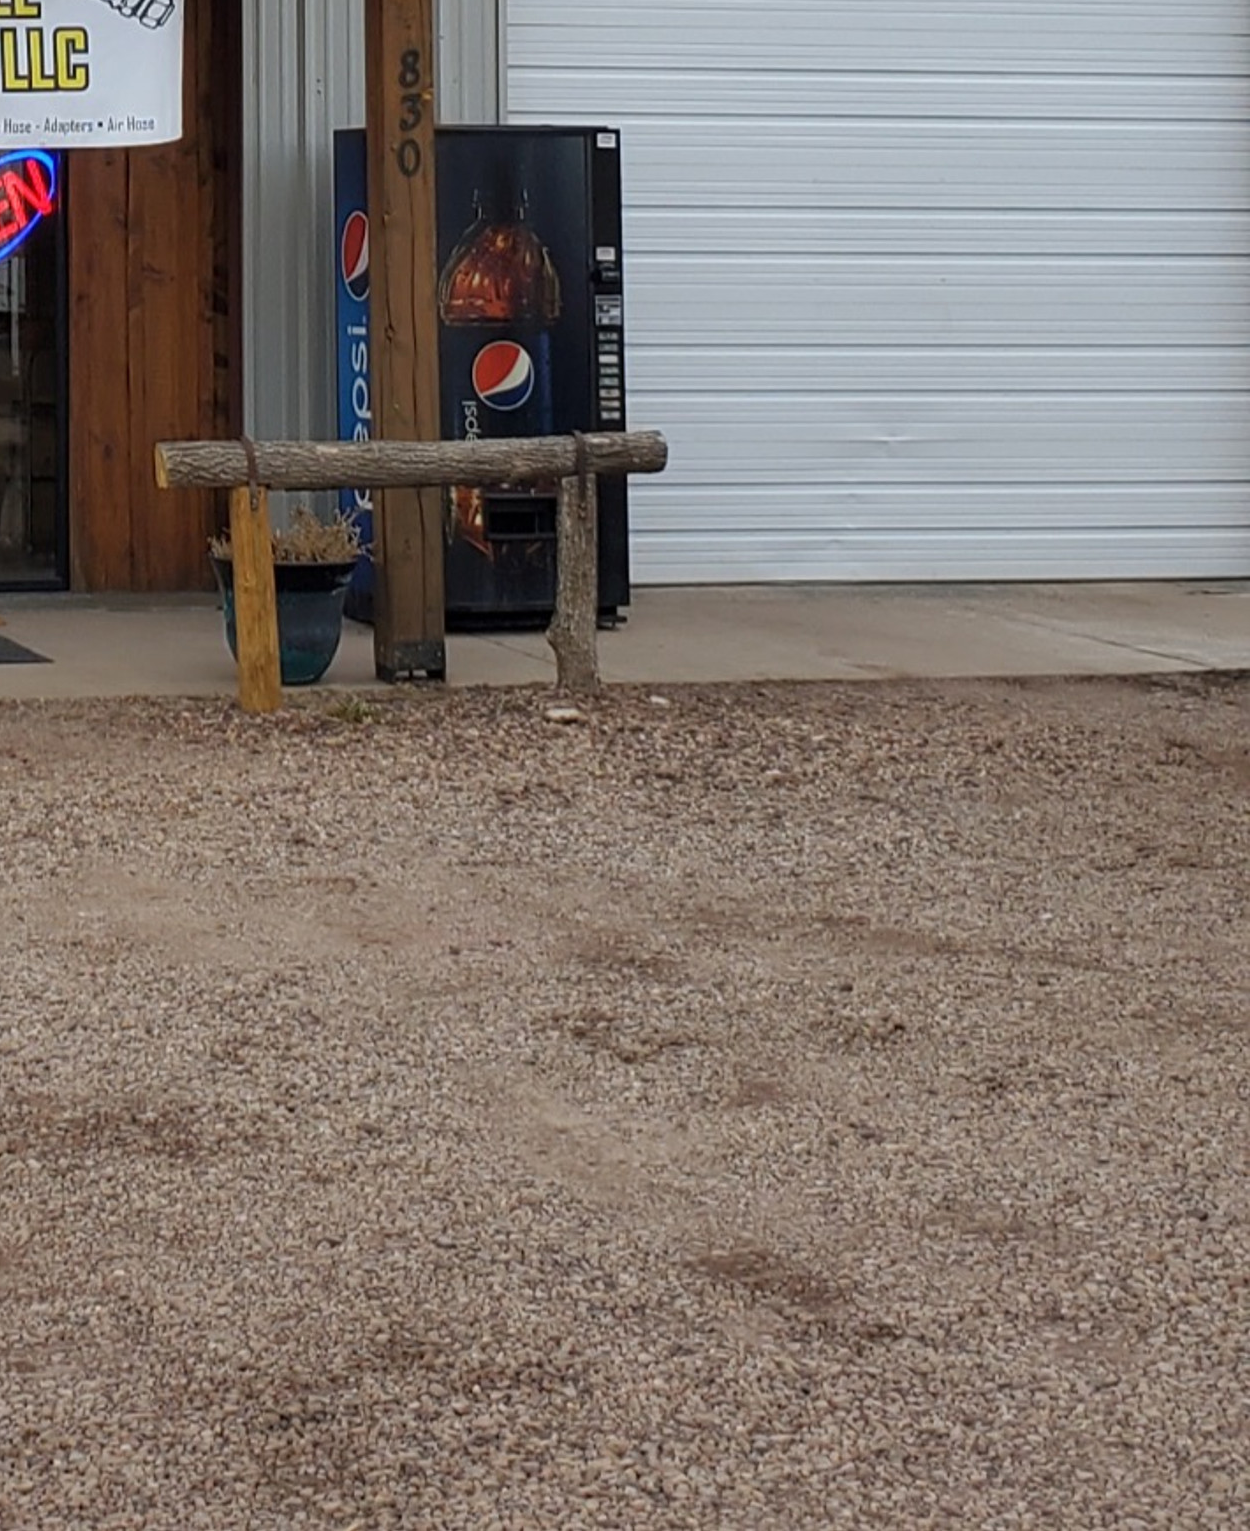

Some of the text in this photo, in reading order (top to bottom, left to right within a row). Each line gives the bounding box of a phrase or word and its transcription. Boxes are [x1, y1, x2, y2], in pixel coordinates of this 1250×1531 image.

[0, 27, 89, 93] LLC
[3, 118, 32, 134] Hose
[43, 117, 94, 135] Adapters
[107, 117, 124, 132] Air
[126, 116, 155, 131] Hose
